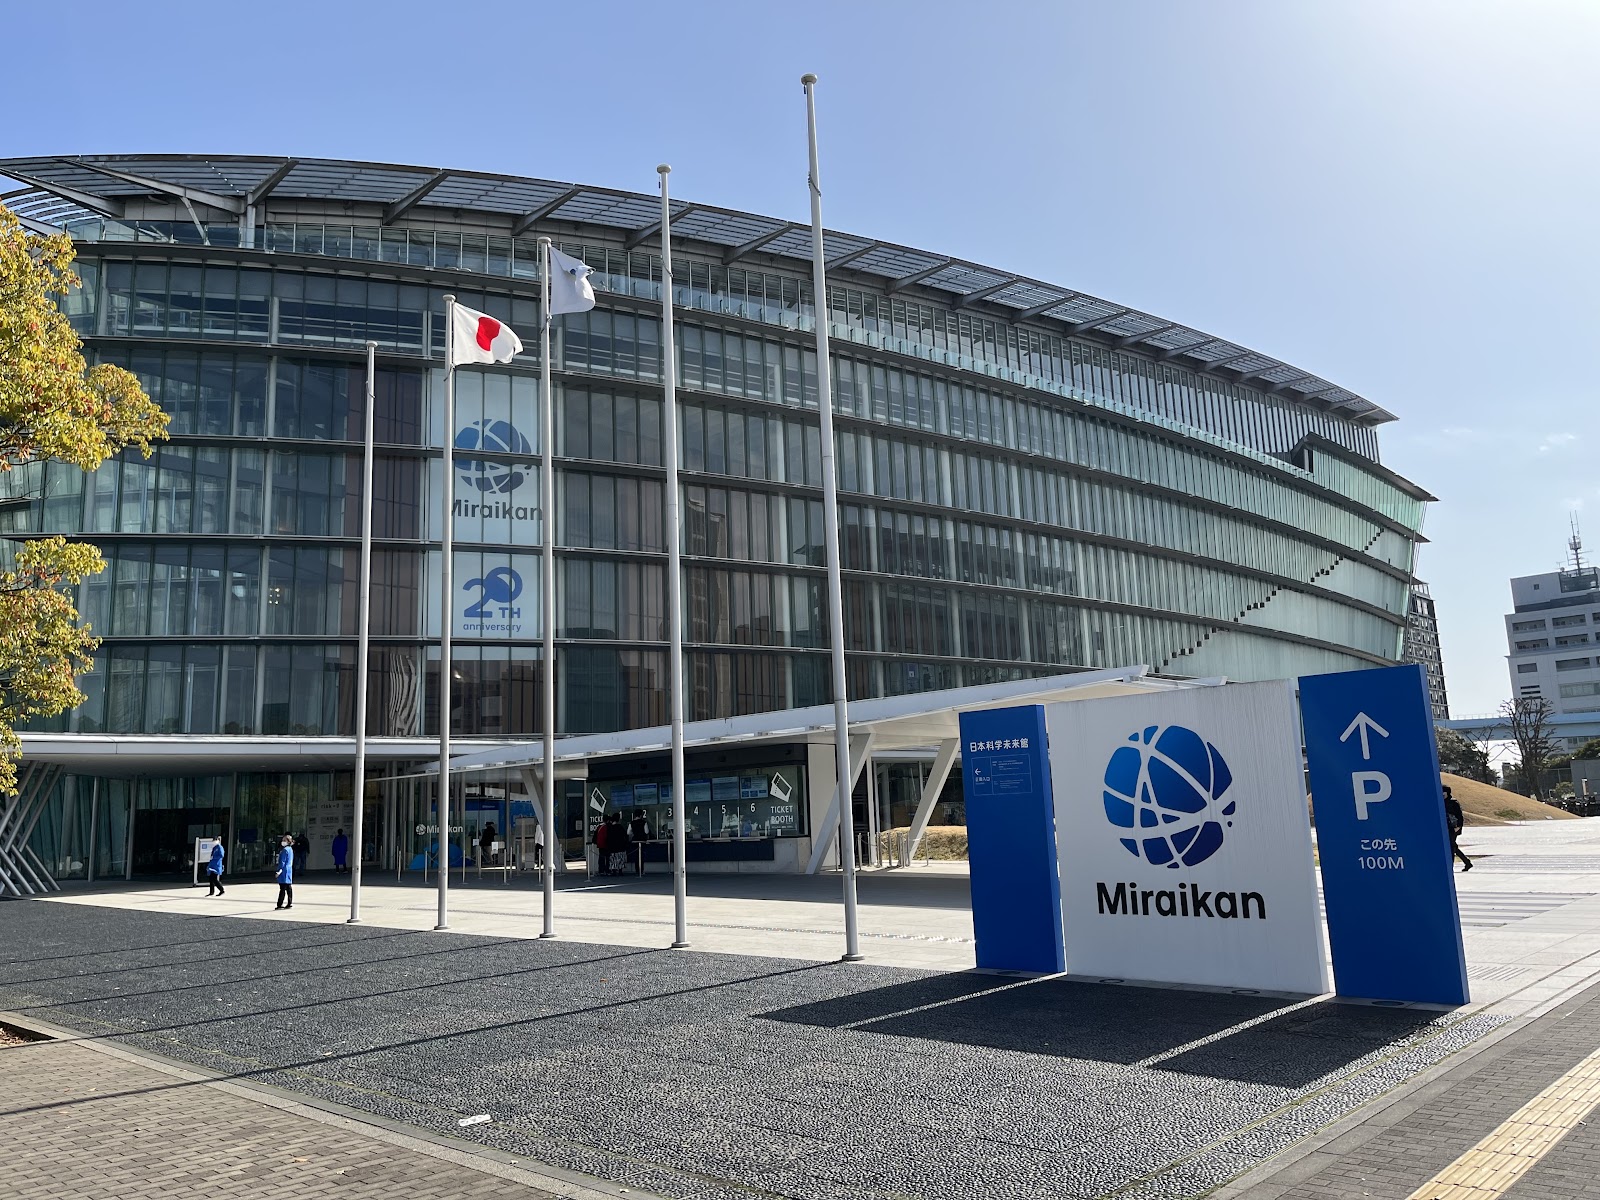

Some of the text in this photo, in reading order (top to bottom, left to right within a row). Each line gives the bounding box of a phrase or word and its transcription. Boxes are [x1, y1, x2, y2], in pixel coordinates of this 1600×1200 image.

[463, 622, 522, 632] anniversary
[969, 738, 1029, 752] 日本科学未来館
[1351, 770, 1392, 821] P
[693, 806, 699, 815] 4
[721, 804, 726, 814] 5
[750, 802, 756, 812] 6
[770, 805, 793, 813] TICKET
[642, 809, 647, 819] 2
[667, 808, 672, 817] 3
[589, 815, 604, 823] TICKE
[770, 815, 794, 823] BOOTH
[426, 824, 464, 834] Mirkan
[1360, 837, 1398, 851] この先
[1357, 856, 1405, 870] 100M
[1096, 882, 1267, 920] Miraikan
